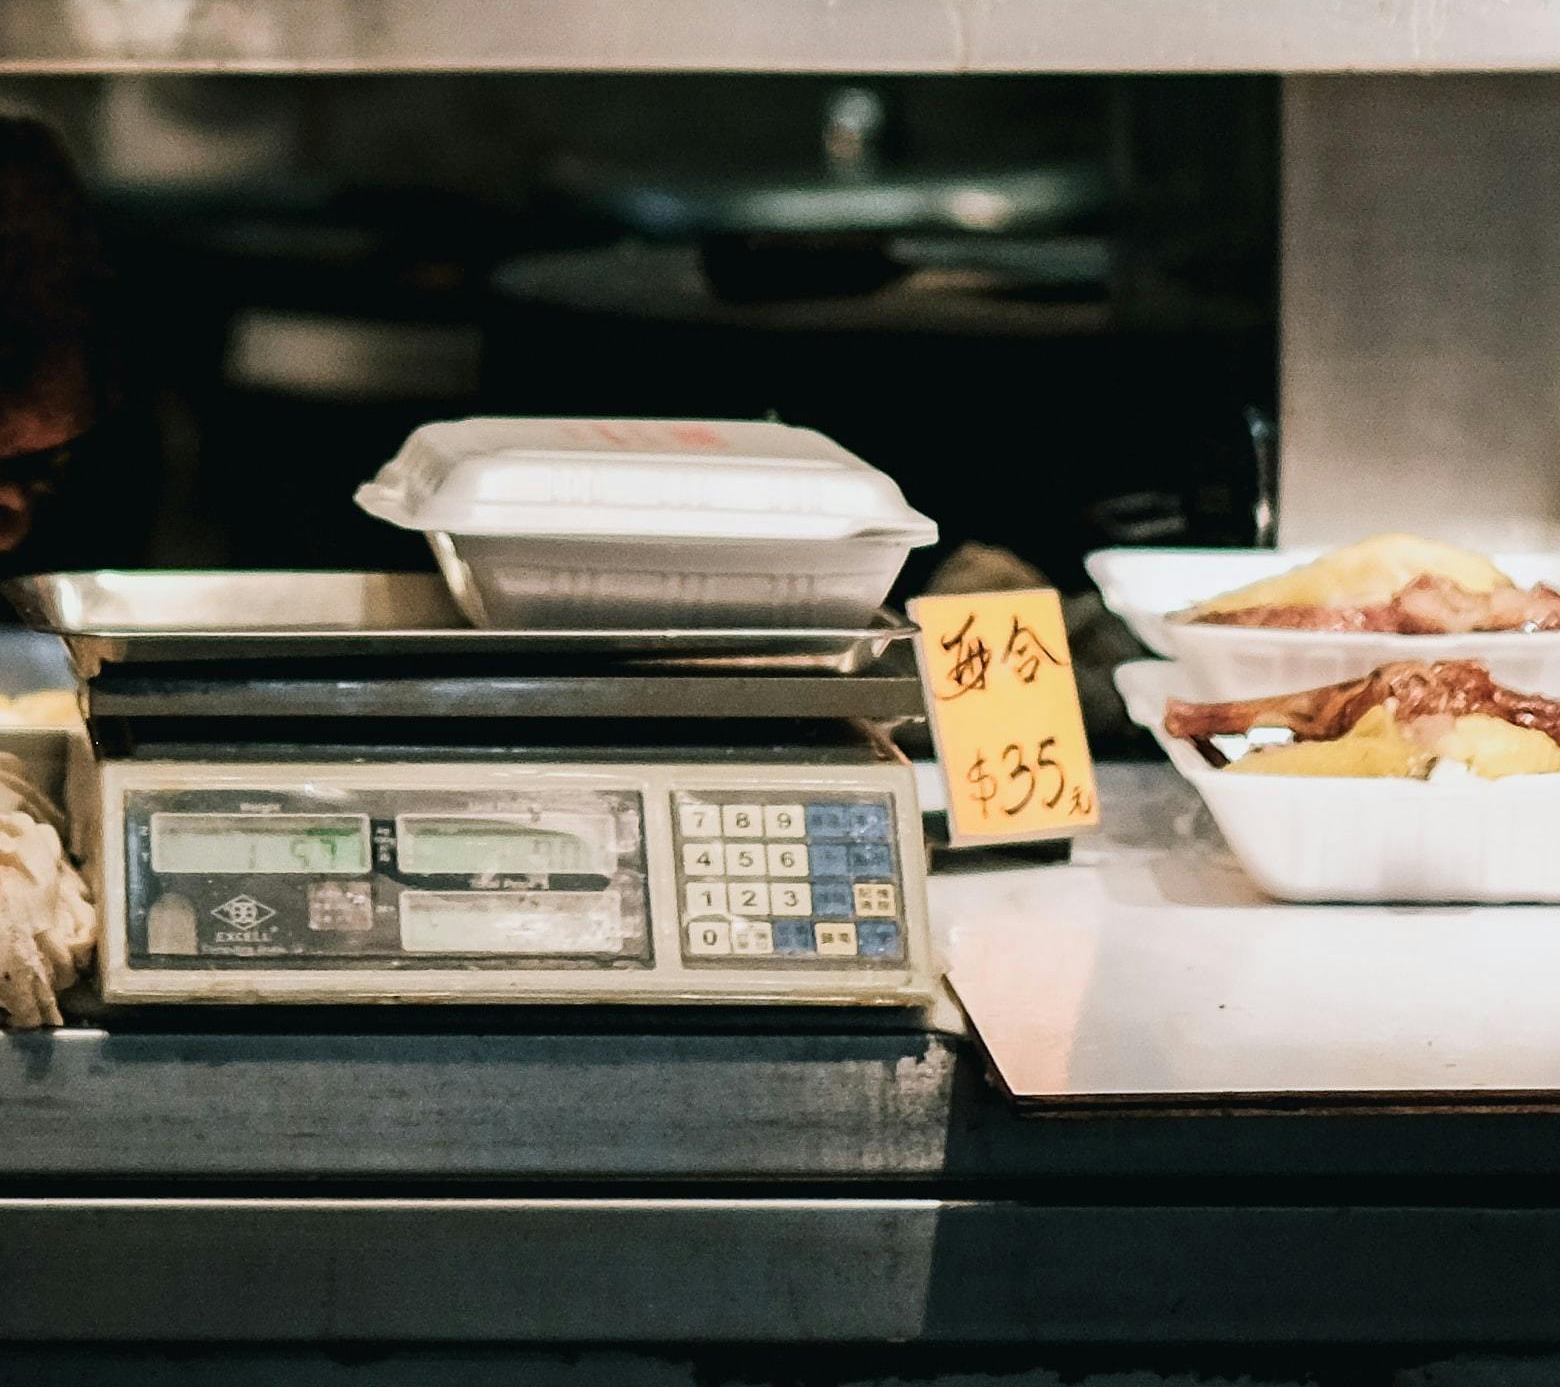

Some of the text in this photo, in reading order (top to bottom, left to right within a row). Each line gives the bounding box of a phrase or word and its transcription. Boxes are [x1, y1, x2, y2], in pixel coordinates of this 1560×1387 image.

[693, 812, 706, 829] 7
[736, 812, 751, 829] 8
[777, 812, 792, 829] 9
[697, 851, 795, 868] 4 5 6
[701, 891, 712, 907] 1
[741, 890, 757, 907] 2
[783, 890, 799, 907] 3
[702, 929, 717, 946] 0
